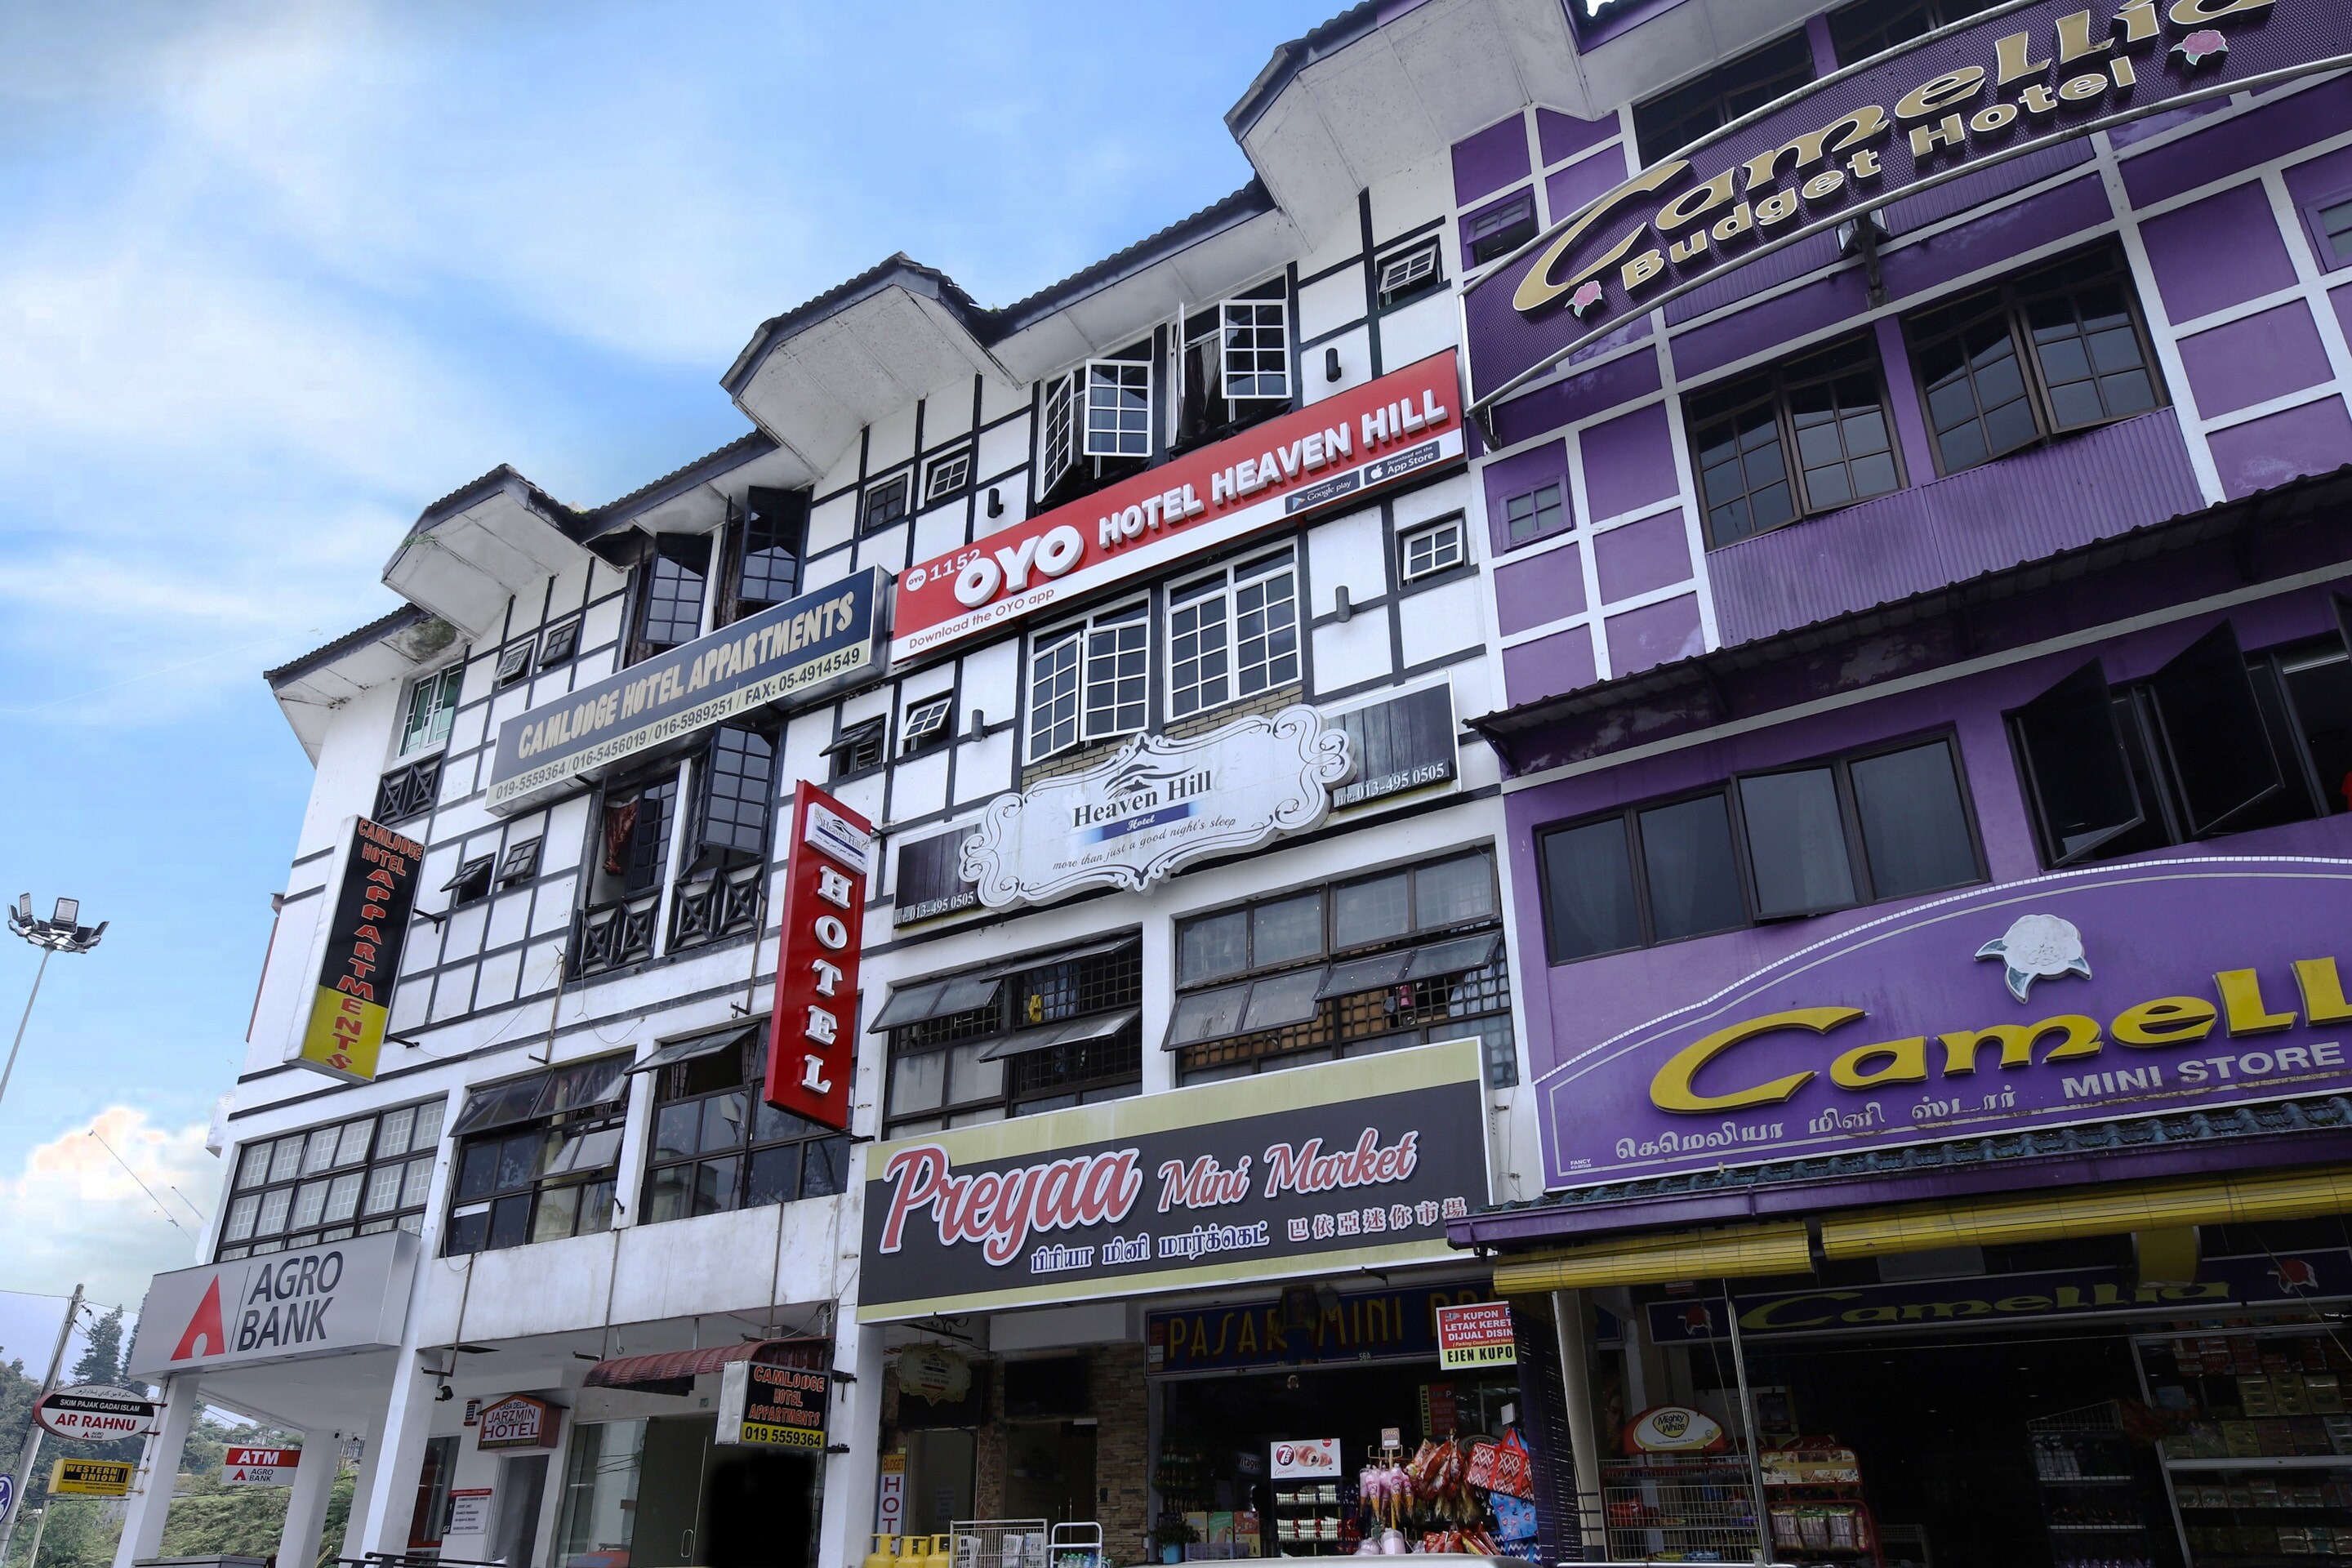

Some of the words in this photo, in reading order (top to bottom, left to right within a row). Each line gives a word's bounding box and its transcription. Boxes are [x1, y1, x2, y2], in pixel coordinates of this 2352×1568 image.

[1620, 148, 1881, 291] Budget
[1909, 56, 2136, 159] Hotel
[1387, 452, 1414, 466] Download
[1388, 462, 1407, 475] App
[1409, 452, 1434, 467] Store
[954, 525, 1085, 608] OYO
[1099, 483, 1205, 550] HOTEL
[1212, 422, 1352, 506] HEAVEN
[1361, 389, 1448, 449] HILL
[1307, 488, 1334, 501] Google
[1336, 481, 1352, 492] play
[909, 575, 924, 586] OYO
[929, 548, 980, 581] 1152
[909, 617, 969, 649] Download
[972, 611, 991, 626] the
[996, 598, 1025, 617] OYO
[1028, 589, 1055, 605] app
[518, 691, 619, 760] CAMLODGE
[621, 664, 684, 719] HOTEL
[686, 590, 855, 694] APPARTMENTS
[497, 761, 565, 800] 019-5559364
[572, 729, 646, 771] 016-5456019
[655, 697, 733, 739] 016-5989251
[745, 683, 776, 705] FAX:
[779, 648, 860, 692] 05-4914549
[1357, 773, 1410, 800] 013-495
[1413, 763, 1445, 784] 0505
[1073, 788, 1158, 828] Heaven
[1166, 770, 1211, 800] Hill
[822, 819, 847, 841] Heaven
[849, 835, 861, 850] Hill
[1126, 813, 1156, 831] Hotel
[358, 819, 423, 862] CAMLODGE
[1052, 860, 1078, 871] more
[1080, 852, 1103, 866] than
[1103, 845, 1127, 864] just
[1129, 842, 1137, 850] a
[1138, 830, 1167, 849] good
[1169, 819, 1205, 840] night's
[1209, 817, 1236, 831] sleep
[361, 842, 407, 877] HOTEL
[910, 898, 948, 920] 013-495
[951, 891, 974, 908] 0505
[325, 868, 395, 1070] APPARTMENTS
[801, 865, 853, 1094] HOTEL
[2061, 1065, 2163, 1100] MINI
[2176, 1041, 2345, 1083] STORE
[1809, 1102, 1885, 1134] மினி
[880, 1143, 1143, 1266] Preyaa
[1157, 1153, 1252, 1213] Mini
[1263, 1127, 1419, 1198] Market
[1288, 1196, 1468, 1242] 巴依亞迷你市場
[1102, 1232, 1151, 1265] மினி
[248, 1251, 344, 1305] AGRO
[237, 1297, 334, 1352] BANK
[1317, 1296, 1403, 1347] MINI
[1445, 1321, 1477, 1331] LETAK
[1479, 1318, 1512, 1329] KERET
[1463, 1310, 1499, 1321] KUPON
[1448, 1331, 1484, 1341] DIJUAL
[1486, 1328, 1513, 1339] DISIN
[1447, 1349, 1474, 1363] EJEN
[754, 1365, 825, 1392] CAMLODGE
[60, 1398, 77, 1406] SKIM
[77, 1401, 98, 1409] PAJAK
[99, 1402, 120, 1410] GADAI
[120, 1404, 140, 1412] ISLAM
[773, 1388, 803, 1407] HOTEL
[55, 1413, 78, 1427] AR
[82, 1415, 136, 1431] RAHNU
[483, 1423, 539, 1438] HOTEL
[488, 1408, 536, 1423] JARZMIN
[748, 1404, 820, 1427] APPARTMENTS
[1658, 1414, 1685, 1425] Mighty
[1663, 1423, 1685, 1432] White
[746, 1426, 768, 1441] 019
[771, 1430, 821, 1447] 5559364
[66, 1464, 118, 1474] WESTERN
[237, 1450, 279, 1465] ATM
[883, 1458, 904, 1471] BUDGET
[80, 1473, 117, 1481] UNION
[883, 1477, 900, 1552] HOT
